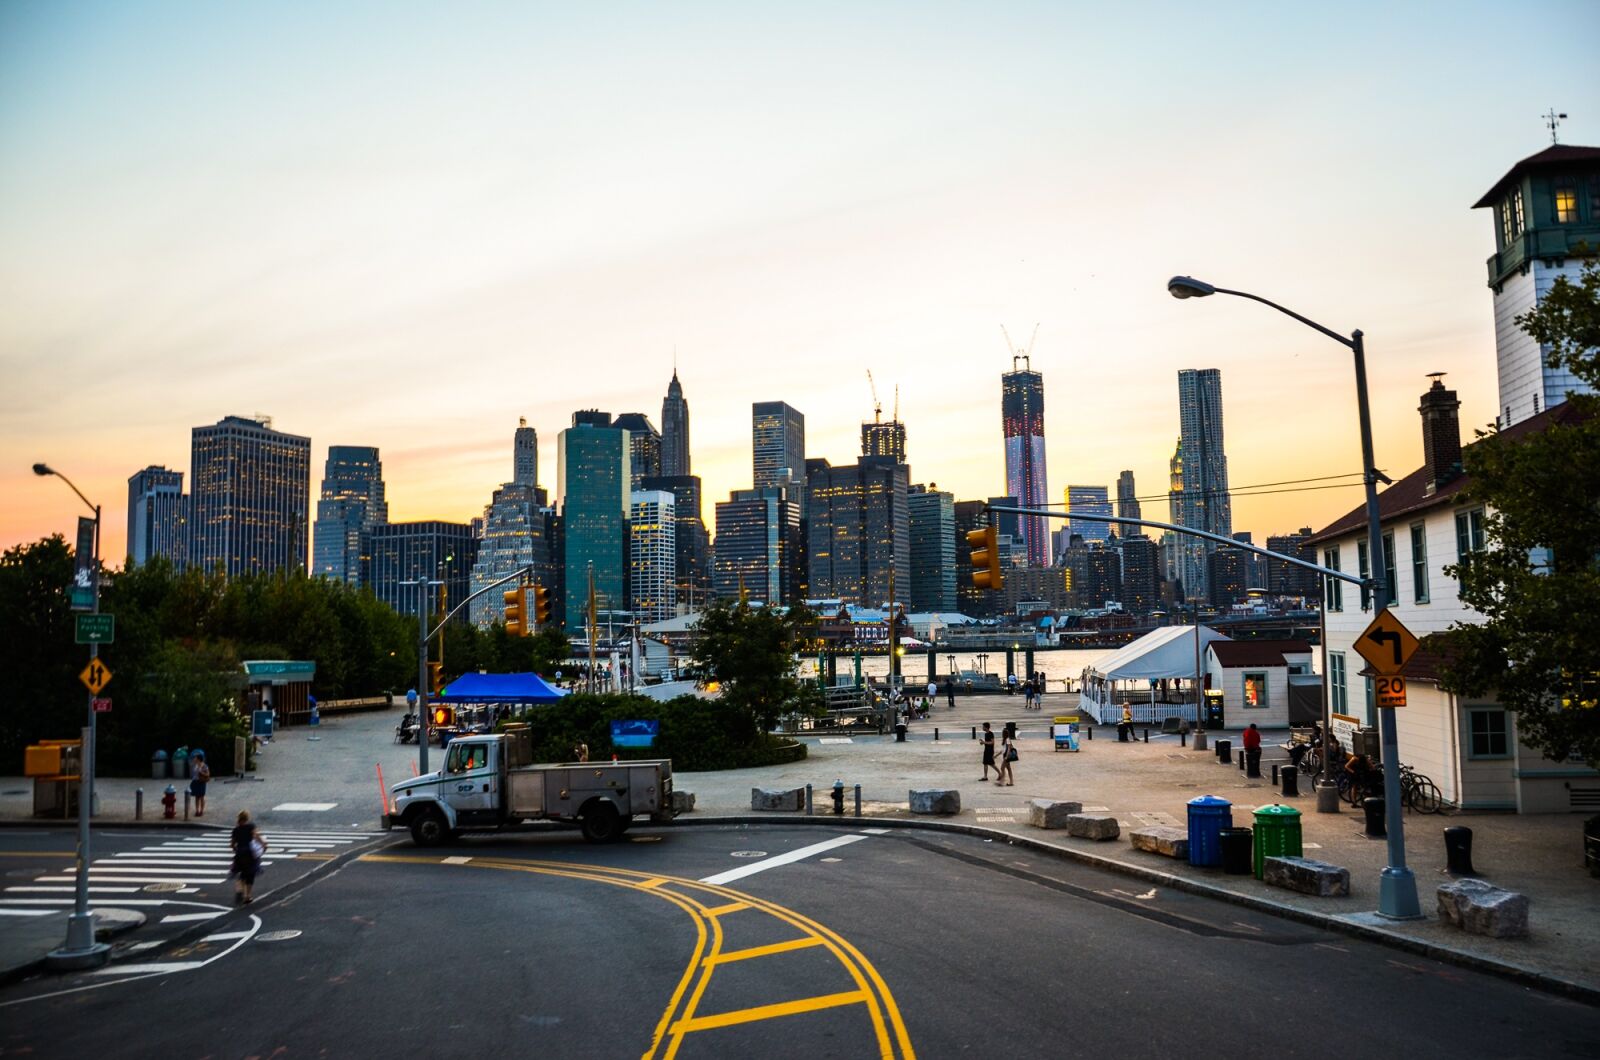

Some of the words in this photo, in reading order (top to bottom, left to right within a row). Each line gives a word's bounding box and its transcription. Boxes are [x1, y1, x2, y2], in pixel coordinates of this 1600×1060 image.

[854, 627, 878, 638] PIER
[880, 627, 889, 638] 17
[1377, 677, 1404, 694] 20
